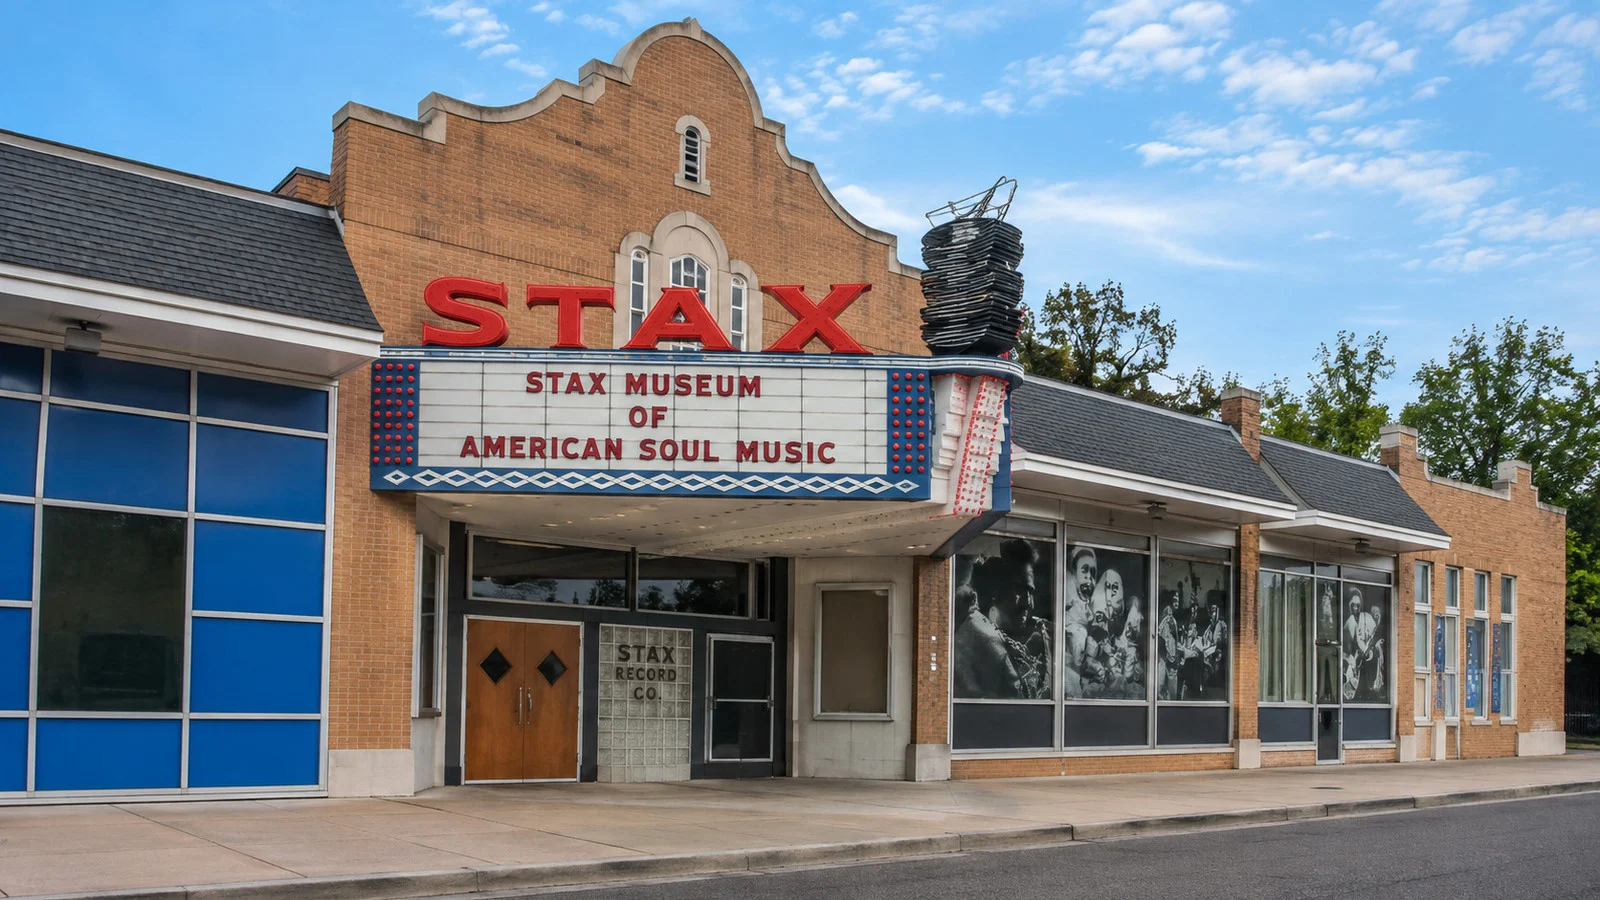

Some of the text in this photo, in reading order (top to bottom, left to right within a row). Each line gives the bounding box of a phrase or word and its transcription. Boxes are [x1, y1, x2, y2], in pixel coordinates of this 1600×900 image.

[421, 276, 872, 354] STAX
[526, 372, 761, 397] STAX MUSEUM
[628, 406, 668, 428] OF
[461, 435, 836, 464] AMERICAN SOUL MUSIC
[618, 644, 675, 663] STAX
[615, 666, 677, 682] RECORD
[634, 687, 662, 700] CO.
